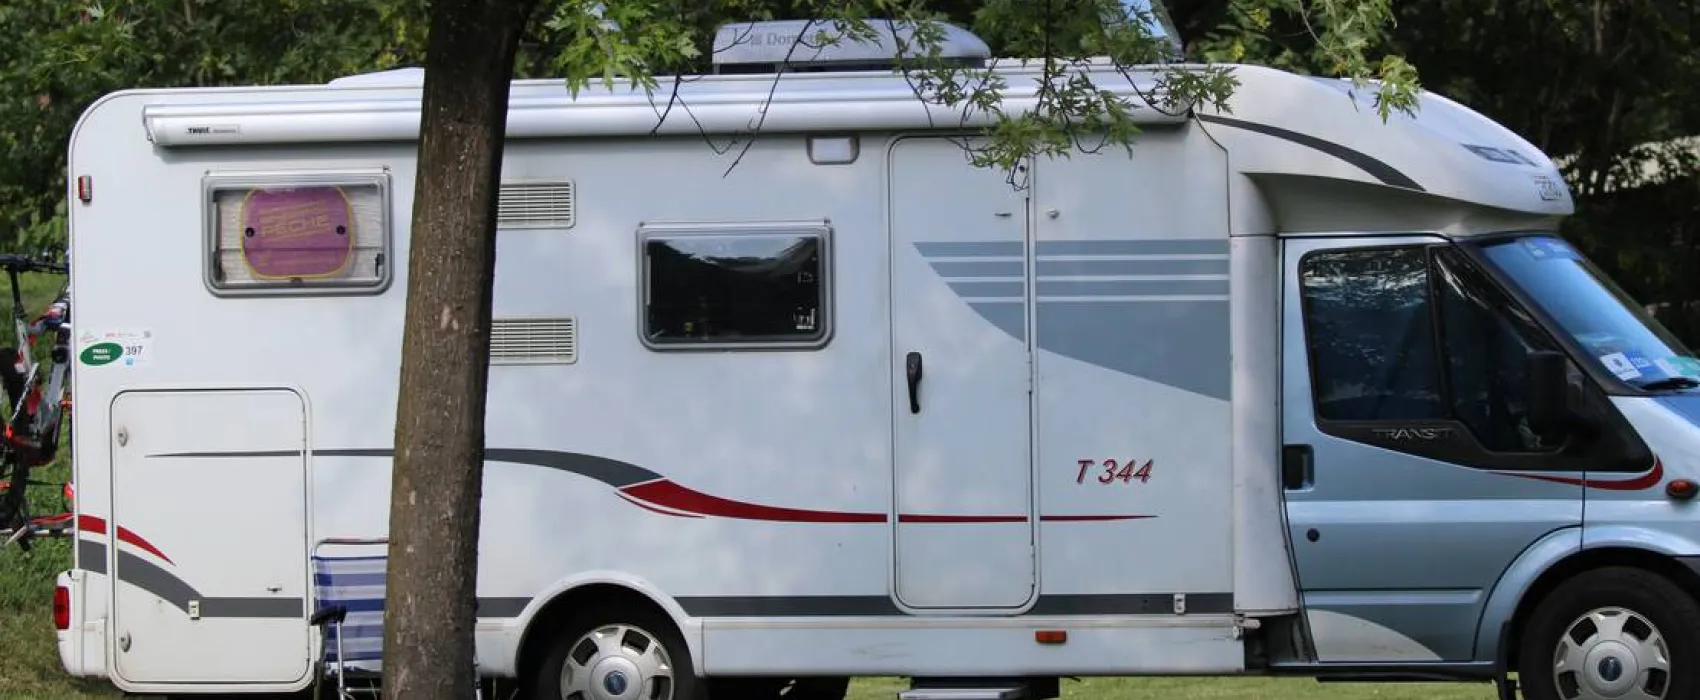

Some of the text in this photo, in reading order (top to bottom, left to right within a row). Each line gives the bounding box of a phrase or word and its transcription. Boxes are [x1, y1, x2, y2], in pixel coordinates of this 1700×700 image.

[124, 345, 143, 356] 397
[1076, 458, 1153, 484] T 344
